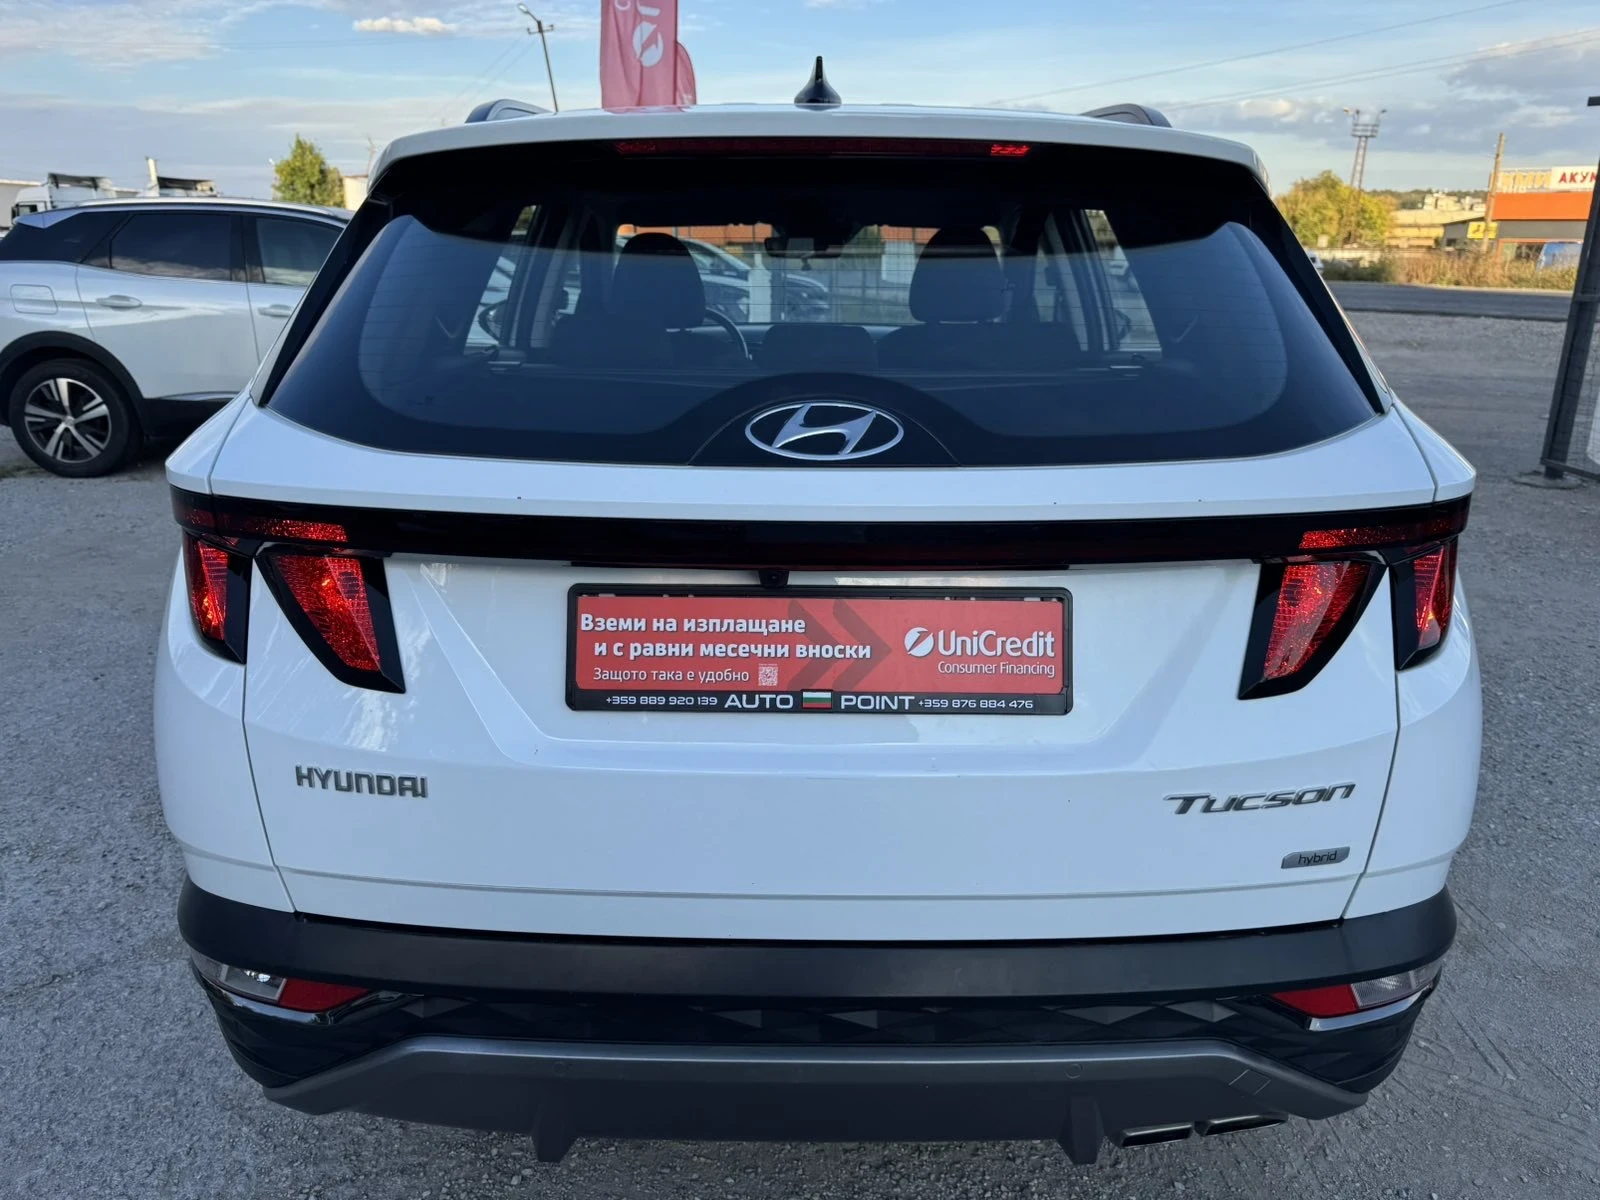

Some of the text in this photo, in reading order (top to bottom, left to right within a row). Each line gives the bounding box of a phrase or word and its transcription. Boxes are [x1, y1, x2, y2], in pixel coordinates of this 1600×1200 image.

[581, 613, 806, 636] Вземи на изплащане
[594, 642, 871, 660] и с равни месечни вноски
[937, 630, 1055, 657] UniCredit
[593, 667, 750, 683] Защото така е удобно
[937, 661, 1055, 678] Consumer Financing
[606, 694, 1034, 710] +359 889 920 139 AUTO POINT +359 876 884 476
[295, 765, 428, 798] HYUNDAI
[1298, 850, 1338, 865] hybrid
